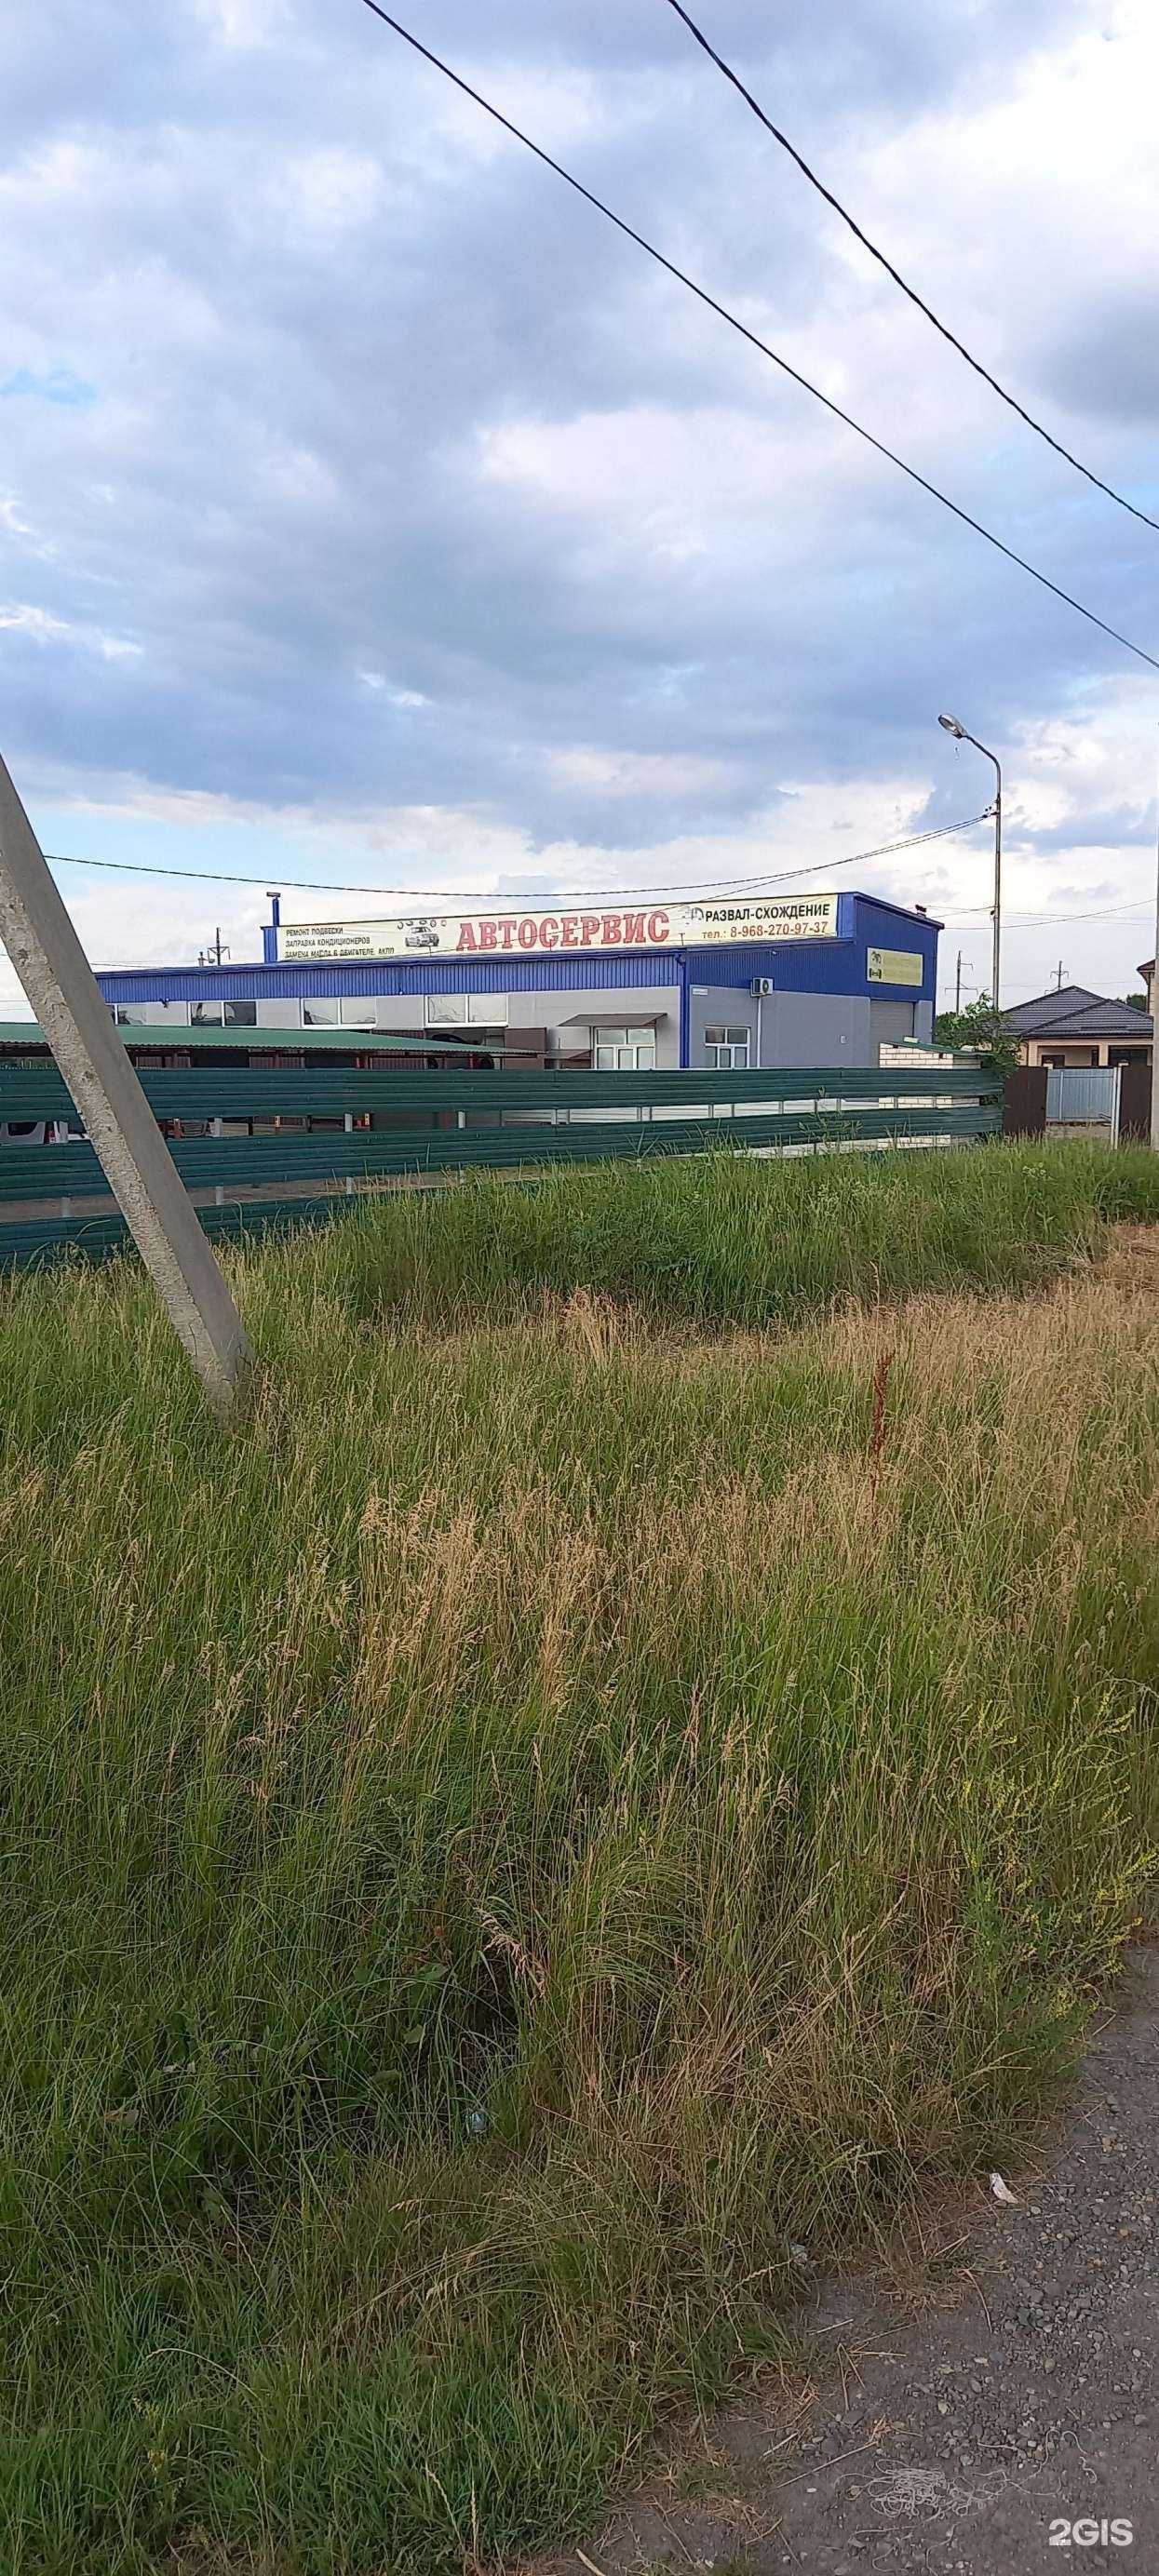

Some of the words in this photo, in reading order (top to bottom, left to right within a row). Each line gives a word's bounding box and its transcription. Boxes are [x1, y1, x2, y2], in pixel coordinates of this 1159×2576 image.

[706, 904, 830, 921] РАЗВАЛ-СХОЖДЕНИЕ
[456, 912, 669, 951] АВТОСЕРВИС
[730, 921, 829, 938] 8-968-270-97-37
[317, 936, 371, 946] КОНДИЦИОНЕРОВ
